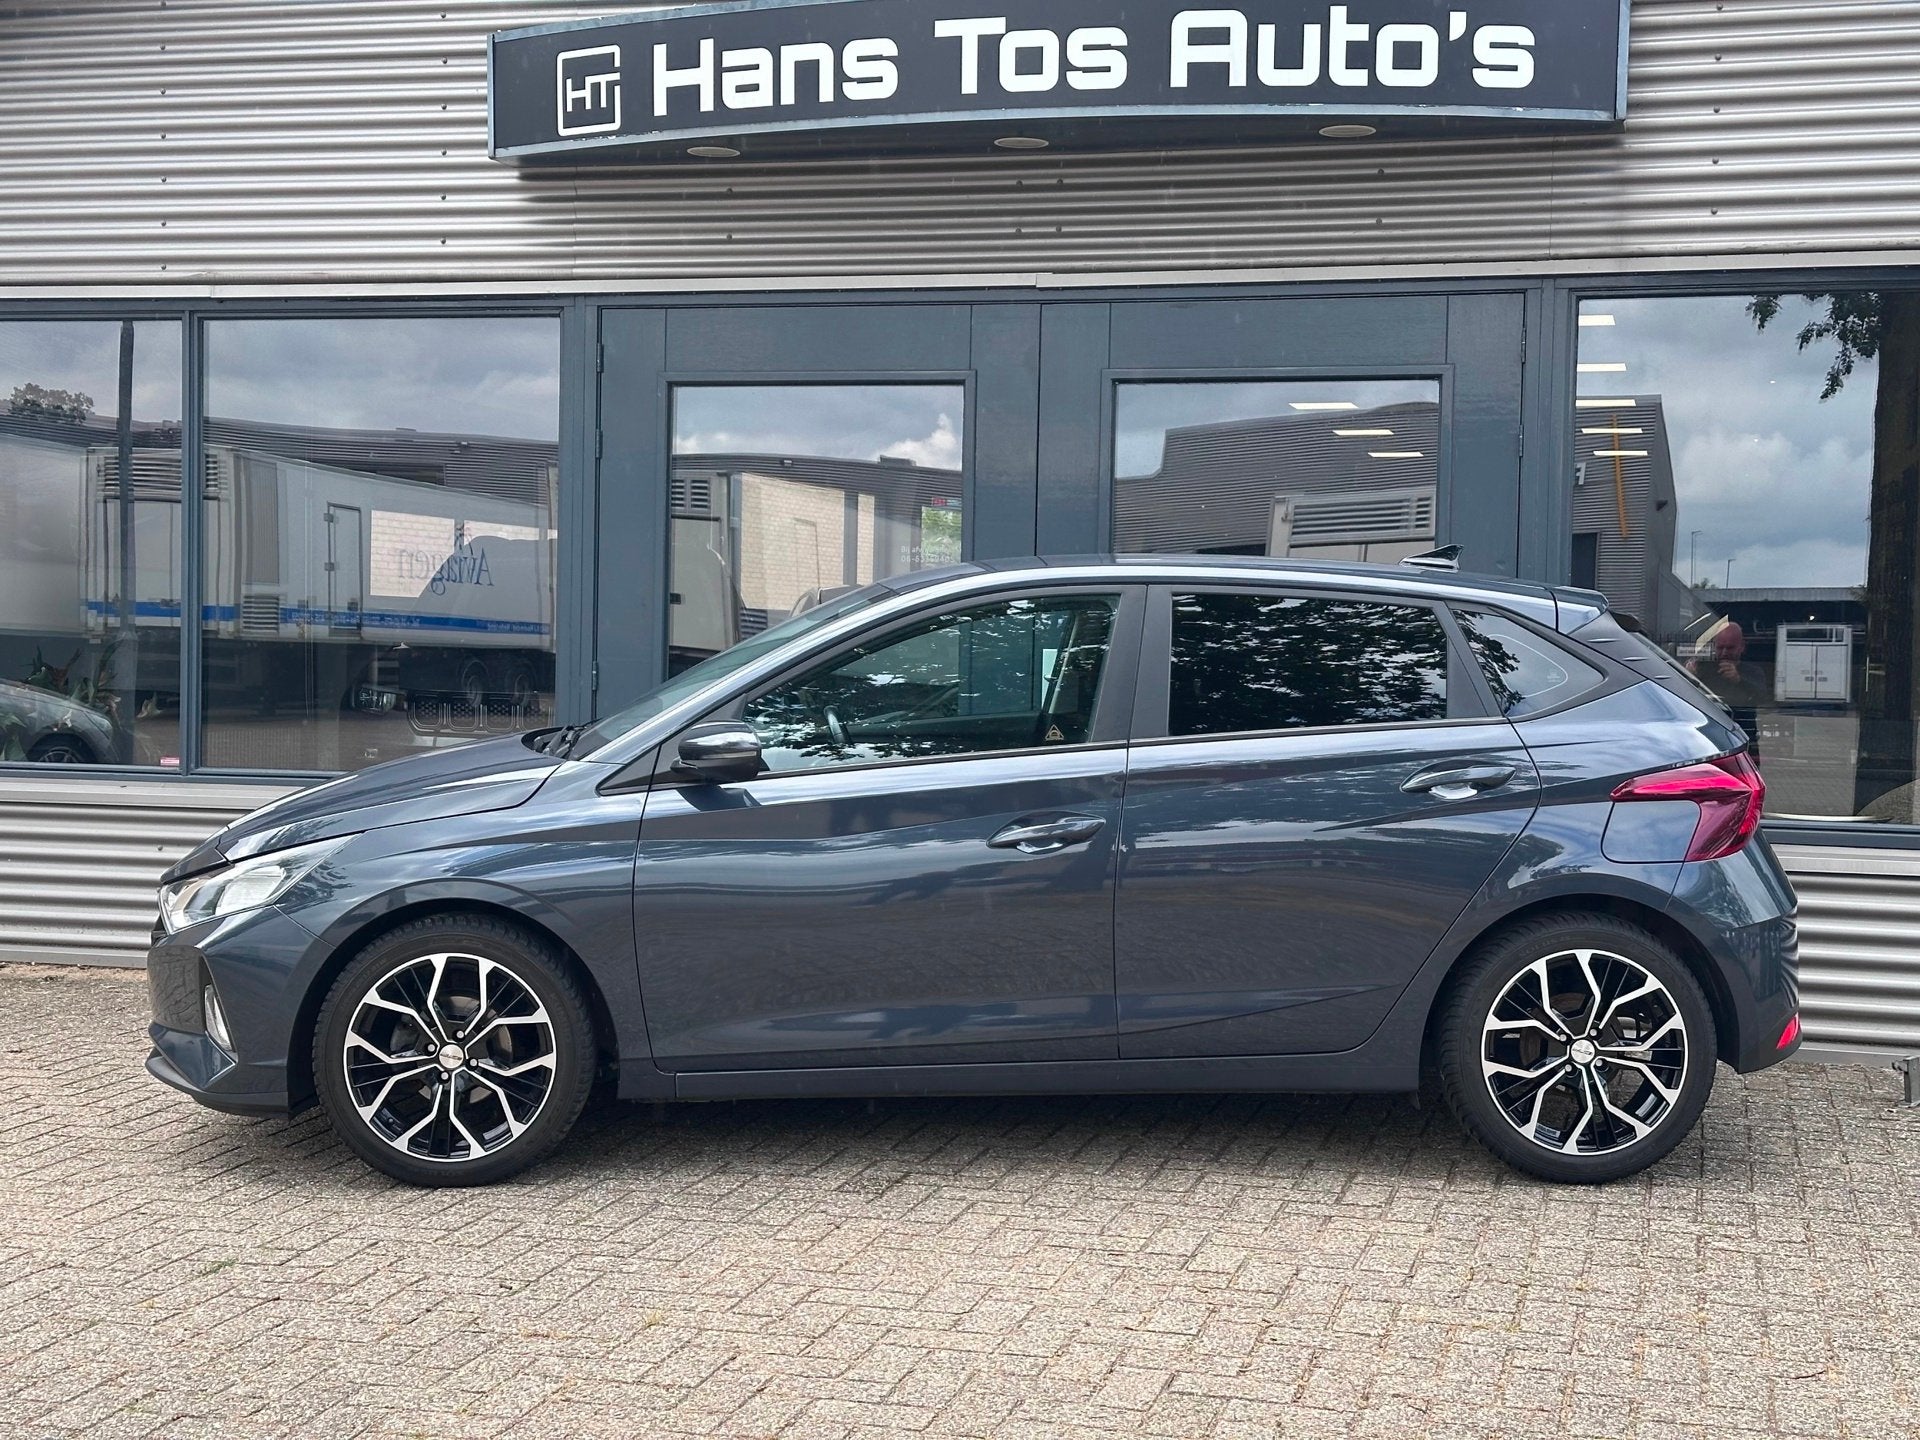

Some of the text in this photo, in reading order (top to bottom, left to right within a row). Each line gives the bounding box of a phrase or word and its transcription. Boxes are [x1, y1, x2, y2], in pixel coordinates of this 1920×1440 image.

[566, 72, 621, 112] HT
[653, 5, 1536, 117] Hans Tos Auto's
